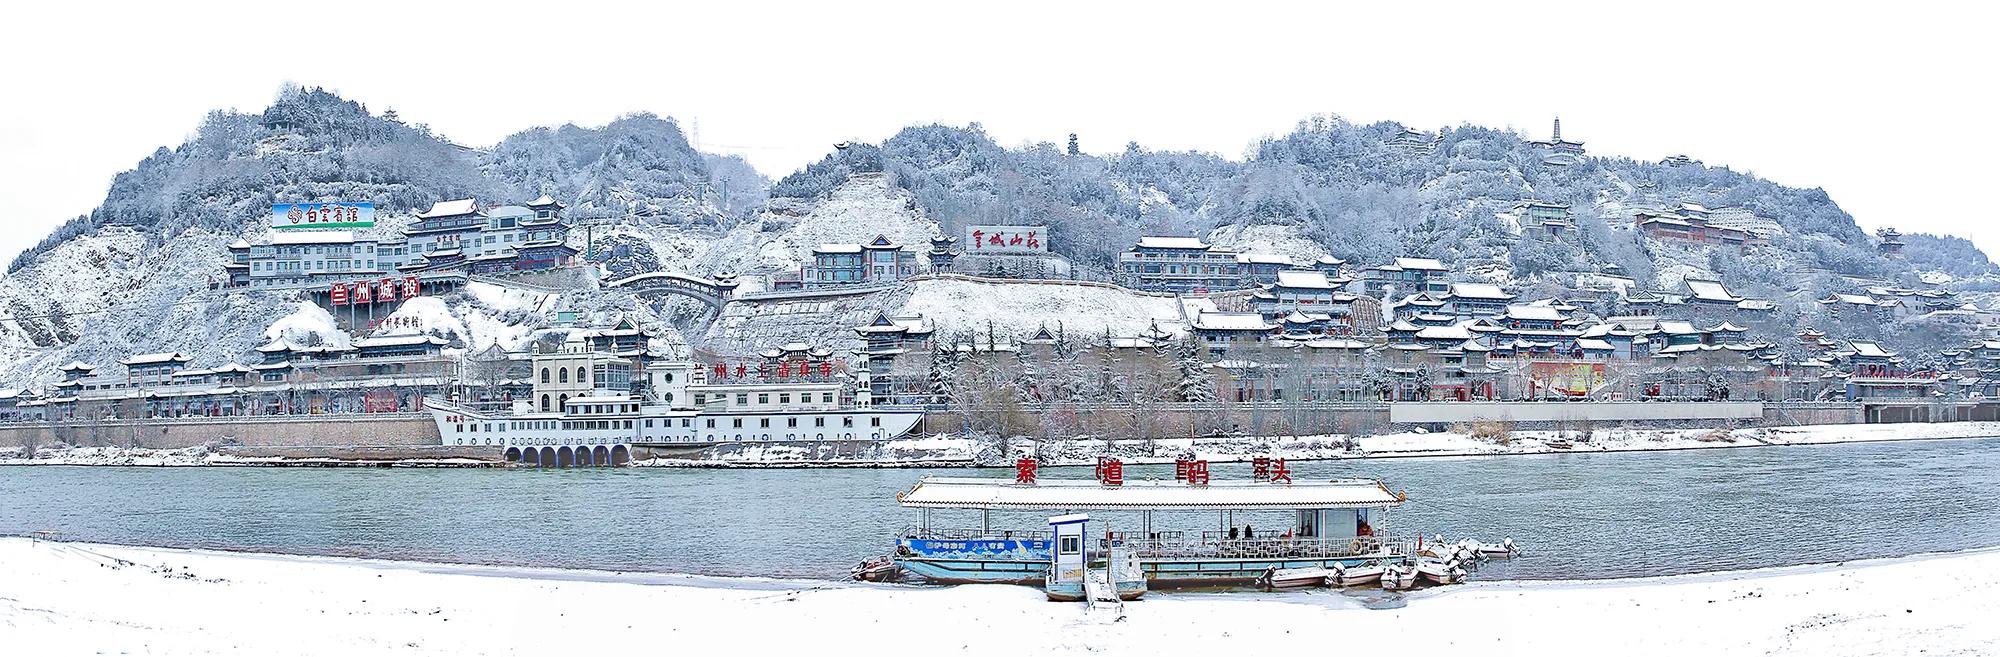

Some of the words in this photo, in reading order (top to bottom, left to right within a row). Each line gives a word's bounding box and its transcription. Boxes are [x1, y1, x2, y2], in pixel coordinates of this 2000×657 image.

[333, 278, 417, 302] 兰州城投
[694, 361, 832, 379] 兰州水上清真寺
[1016, 458, 1292, 485] 索道码头
